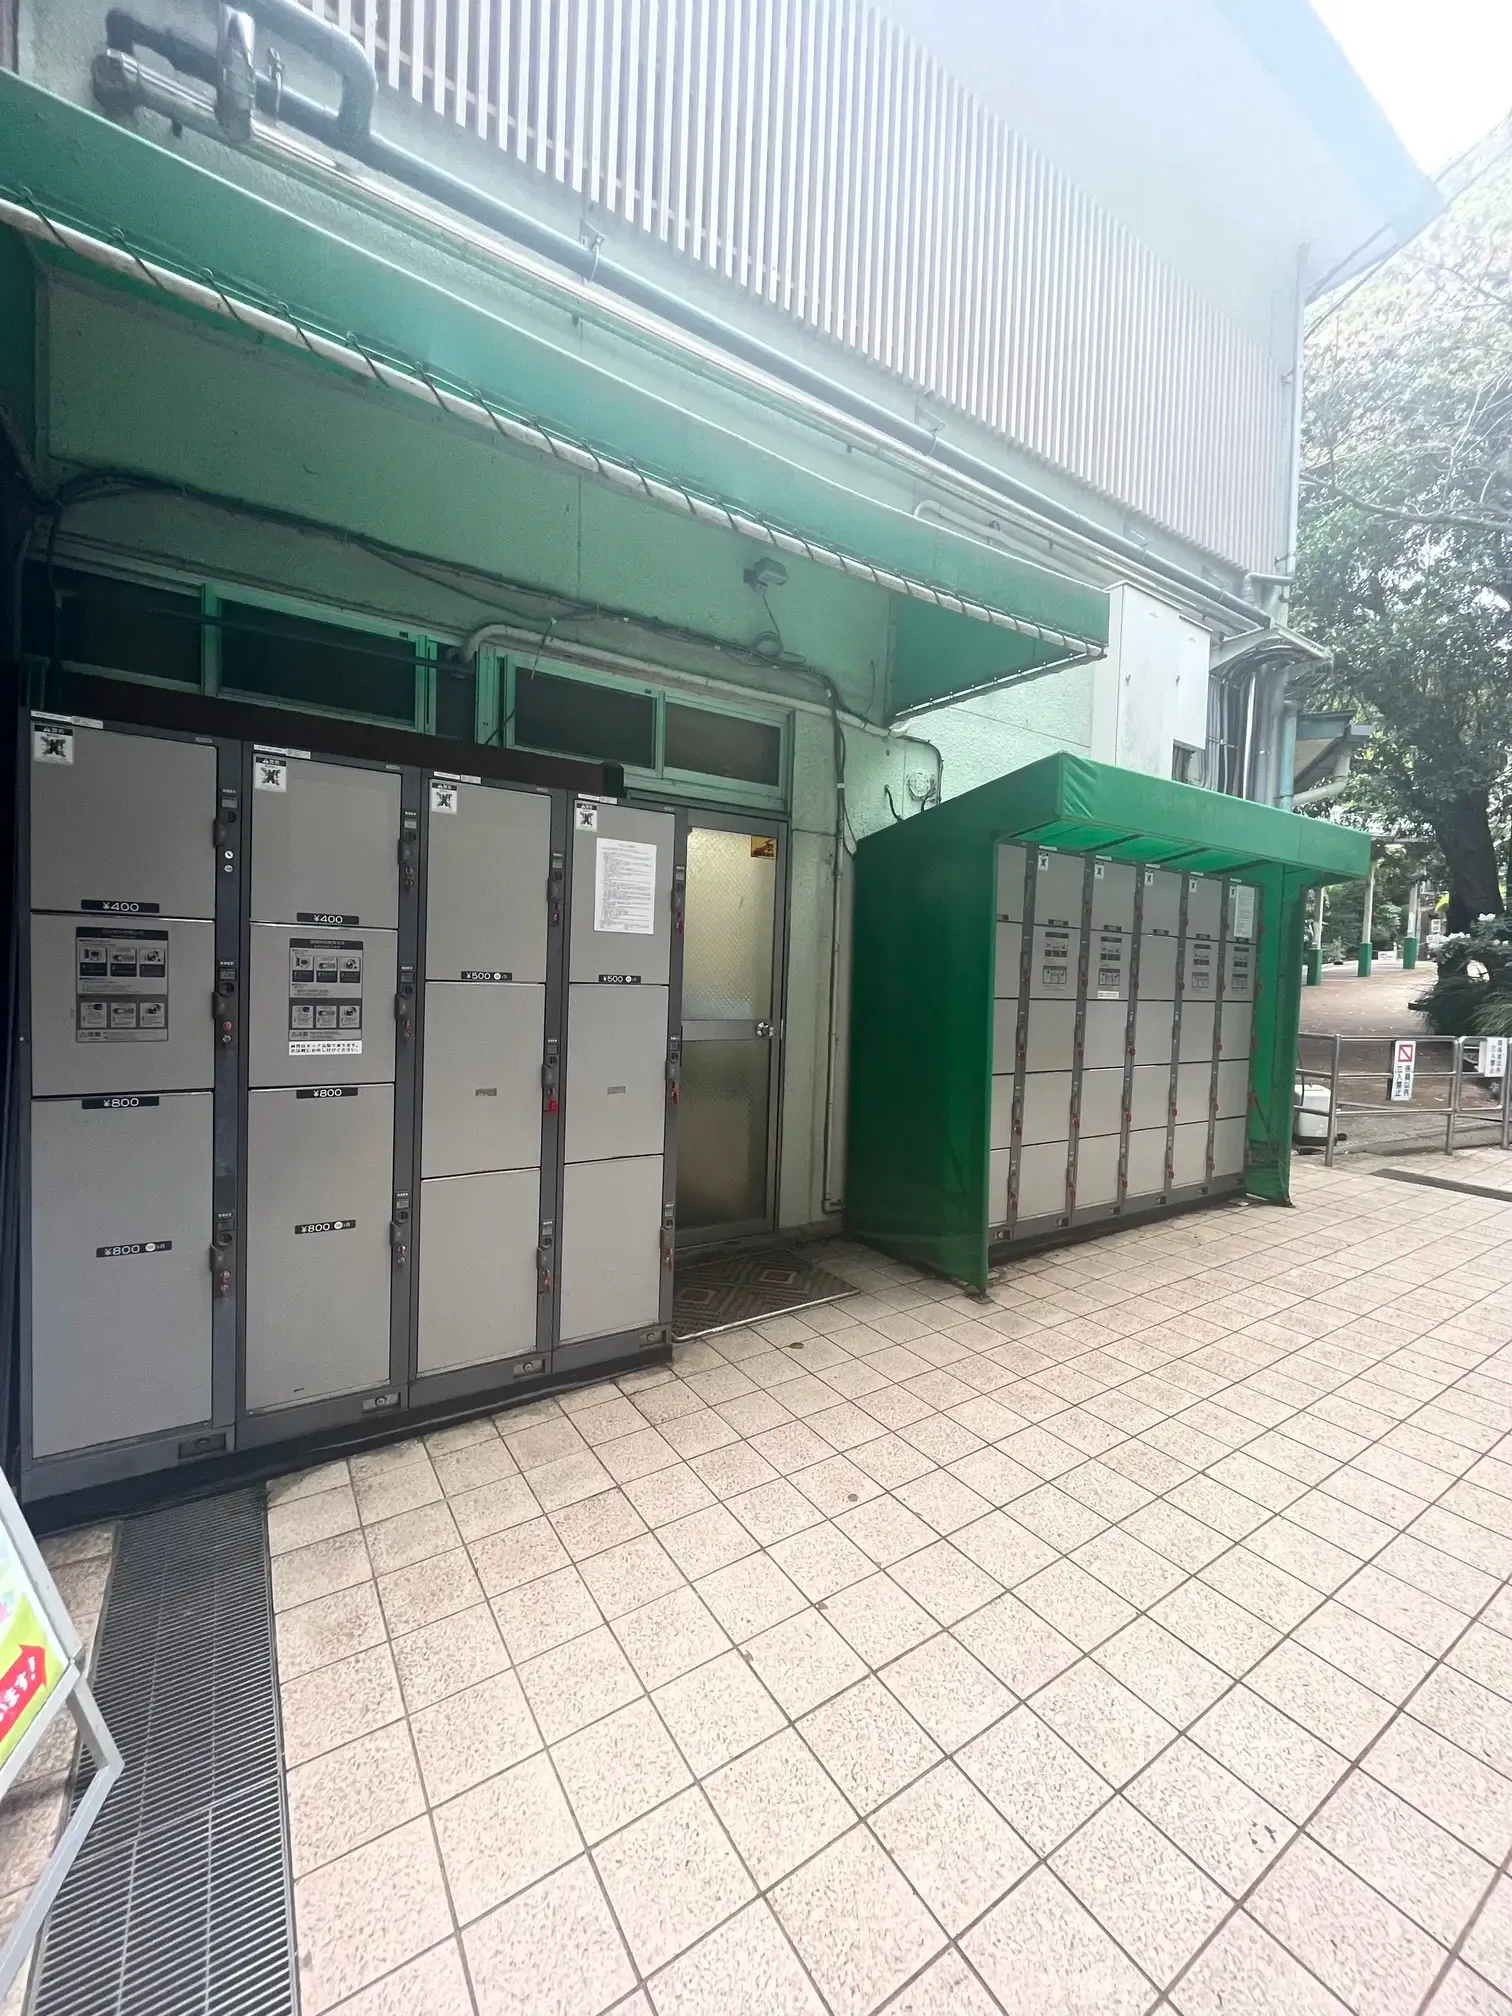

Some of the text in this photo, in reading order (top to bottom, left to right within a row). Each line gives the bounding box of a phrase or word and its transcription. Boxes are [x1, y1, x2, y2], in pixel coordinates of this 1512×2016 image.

[102, 901, 140, 913] ¥400
[313, 913, 344, 925] ¥400
[313, 1087, 342, 1097] ¥800
[103, 1097, 140, 1108] ¥800
[300, 1222, 330, 1234] ¥800
[104, 1244, 140, 1256] ¥800
